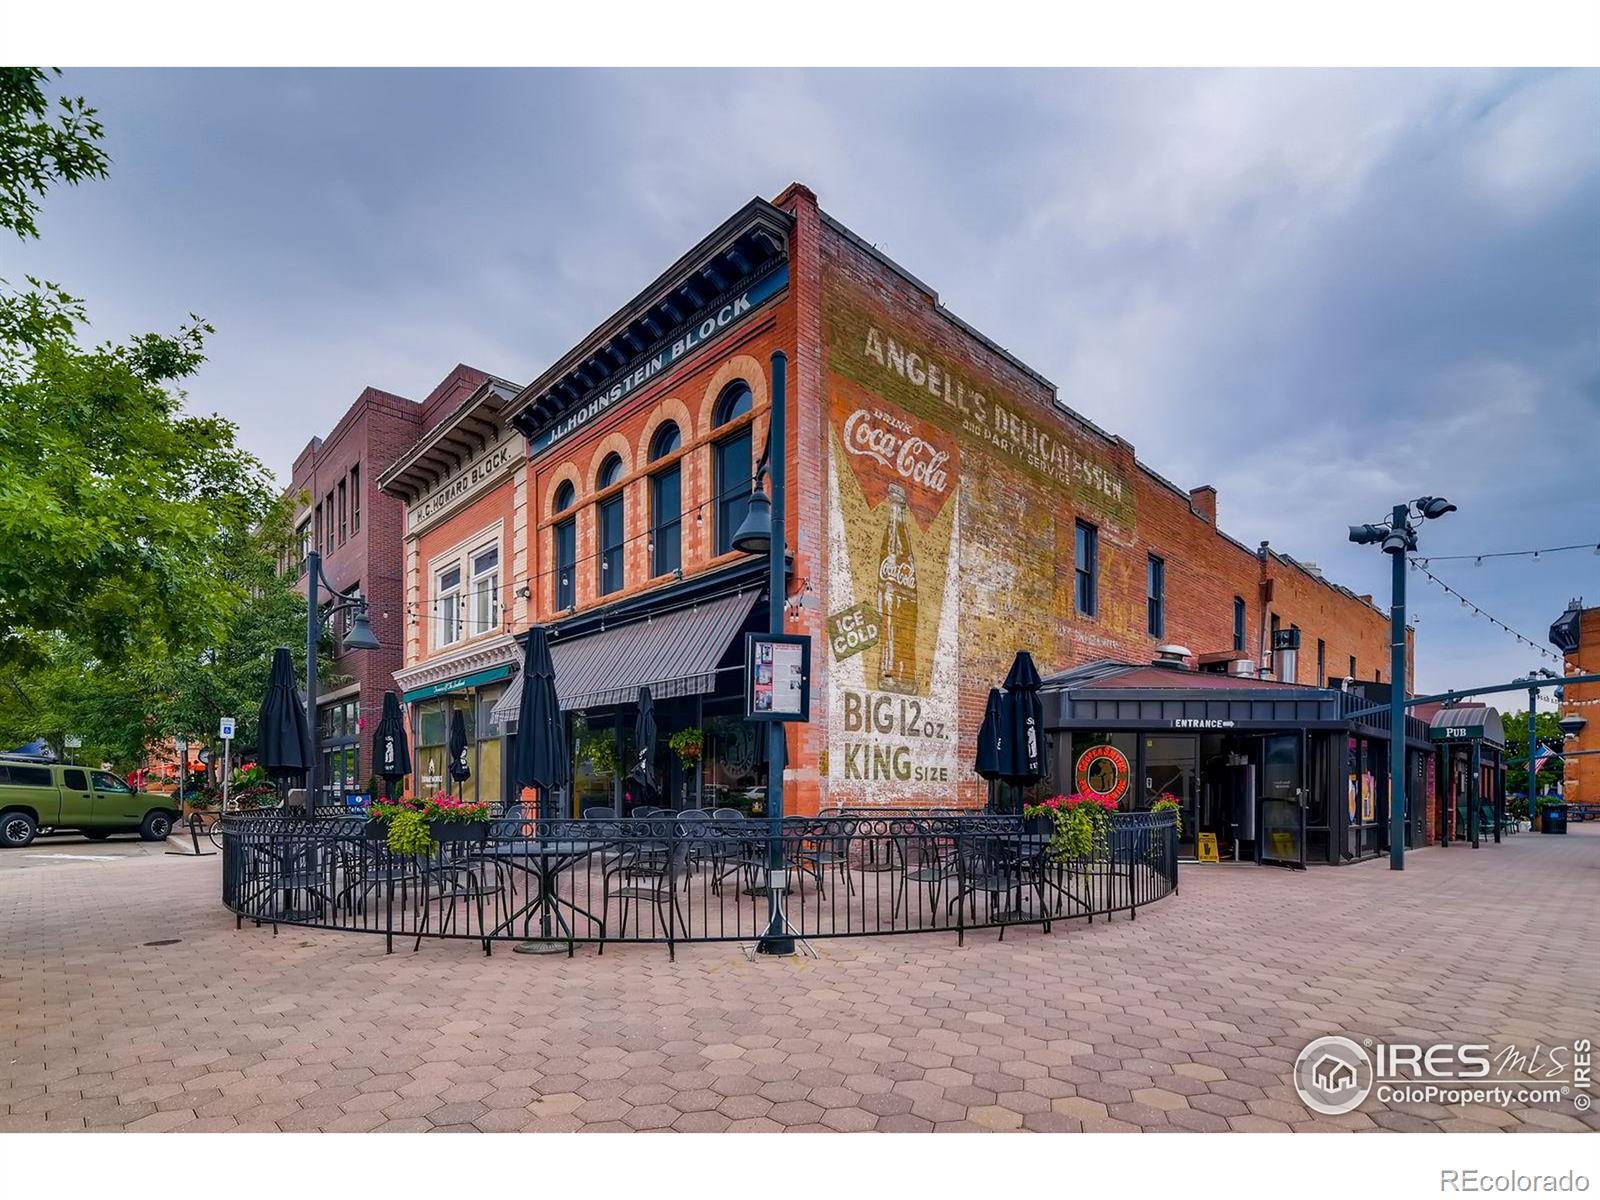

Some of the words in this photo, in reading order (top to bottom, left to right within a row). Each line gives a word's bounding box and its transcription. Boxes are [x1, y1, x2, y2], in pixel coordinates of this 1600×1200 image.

[672, 292, 751, 360] BLOCK
[864, 326, 987, 424] ANGELL'S
[872, 407, 913, 435] DRINK
[471, 447, 512, 484] BLOCK.
[984, 426, 1024, 460] PARTY
[1027, 455, 1071, 486] SERVICE
[833, 623, 878, 654] COLD
[835, 609, 864, 633] ICE
[844, 691, 895, 735] BIG
[900, 698, 922, 738] 12
[1175, 719, 1223, 728] ENTRANCE
[1446, 727, 1467, 738] PUB
[844, 742, 912, 782] KING
[914, 766, 948, 783] SIZE
